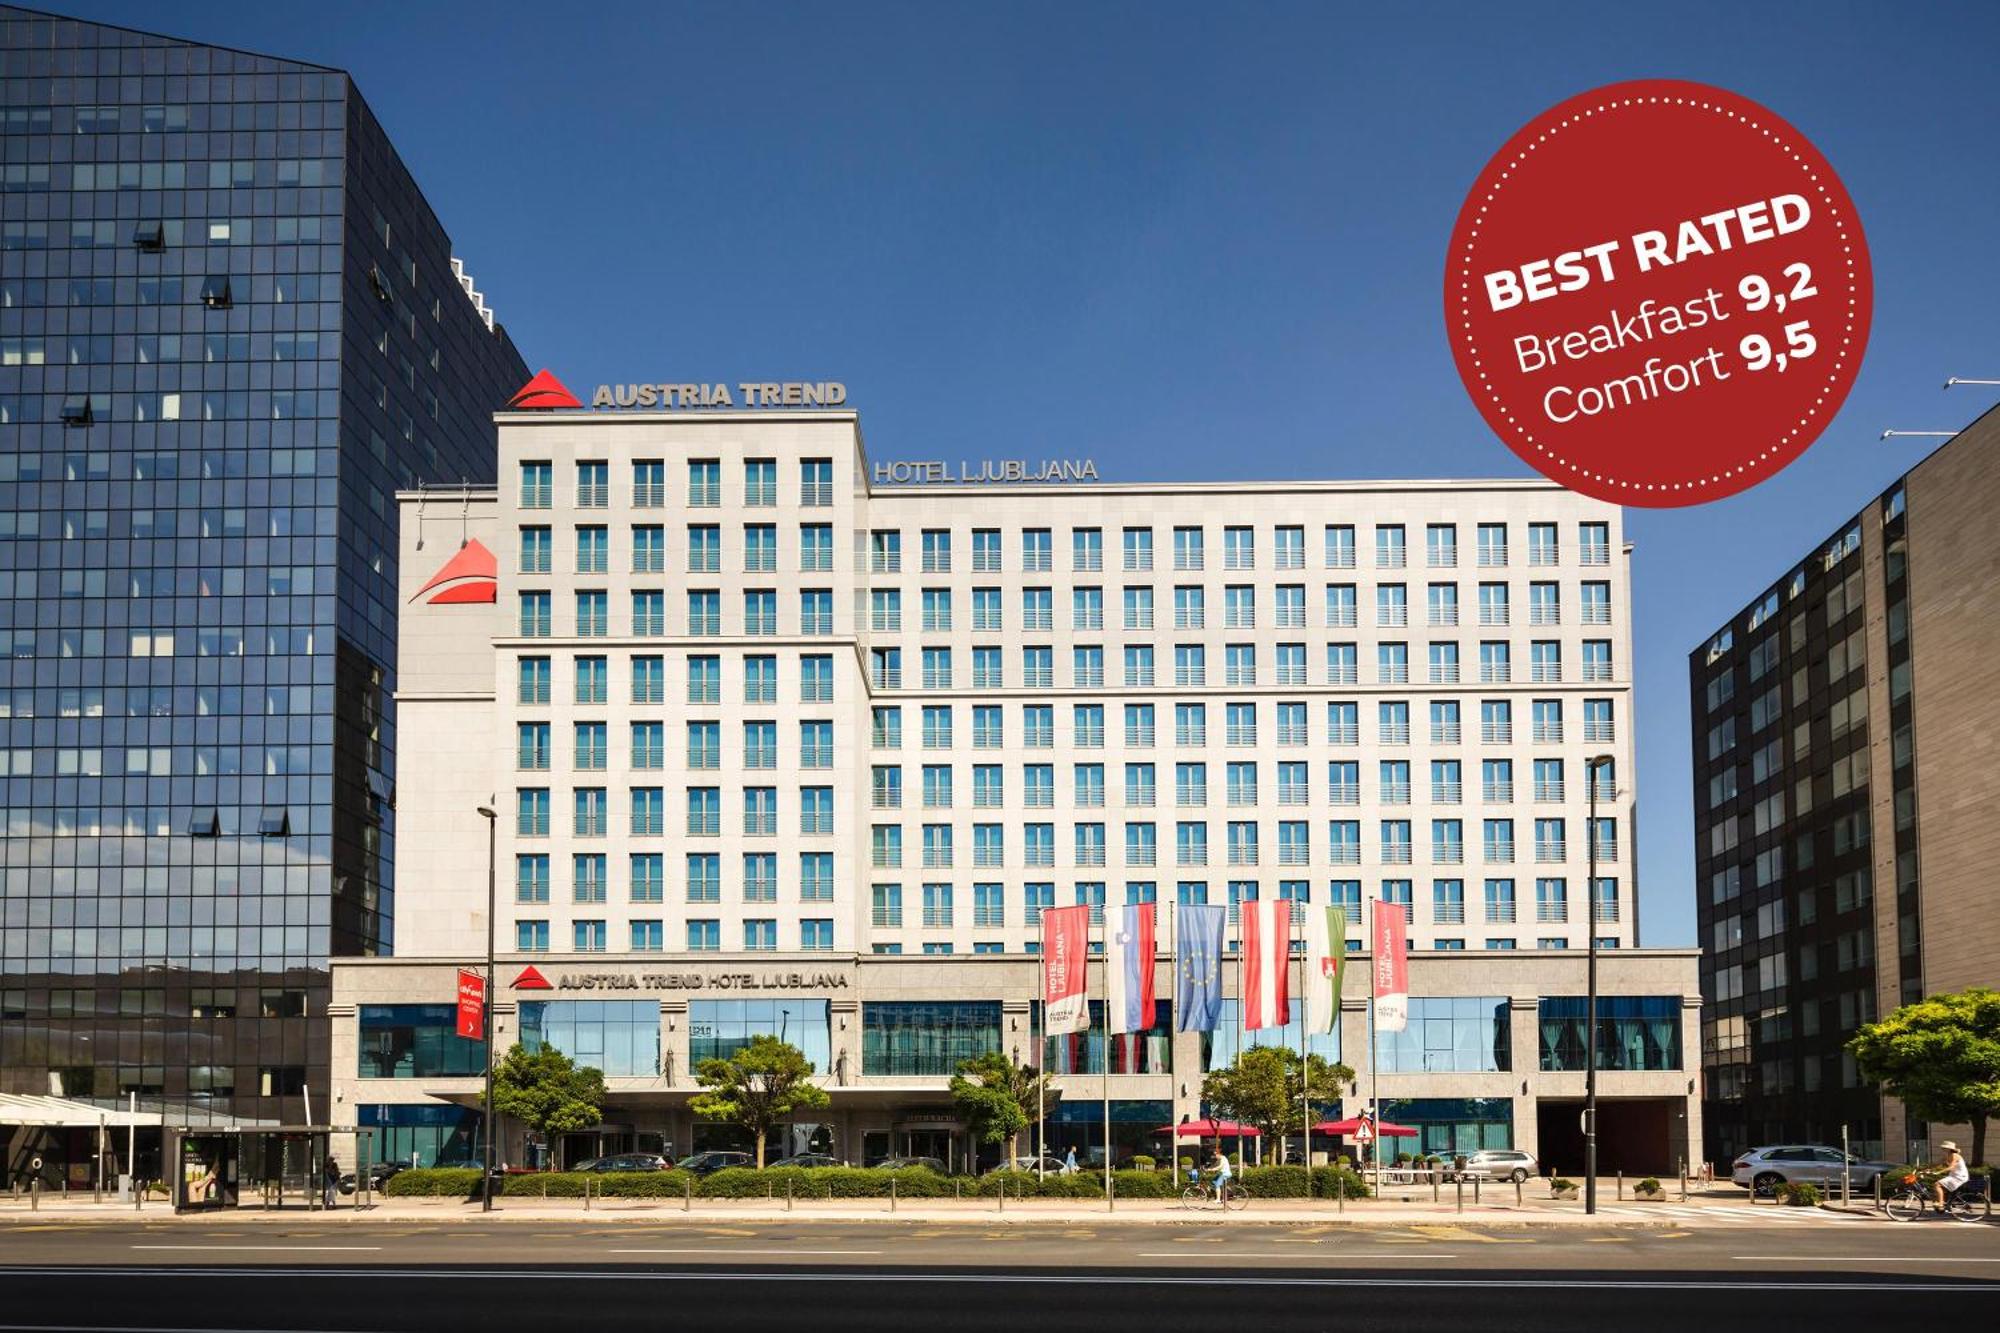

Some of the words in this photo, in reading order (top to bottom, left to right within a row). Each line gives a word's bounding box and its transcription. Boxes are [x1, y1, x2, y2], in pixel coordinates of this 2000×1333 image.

[592, 383, 733, 408] AUSTRIA
[739, 382, 847, 407] TREND
[874, 460, 956, 482] HOTEL
[961, 459, 1099, 482] LJUBLJANA
[1056, 932, 1065, 993] LJUBLJANA
[1384, 928, 1393, 989] LJUBLJANA
[558, 973, 639, 990] AUSTRIA
[643, 973, 704, 990] TREND
[708, 973, 760, 989] HOTEL
[763, 973, 849, 989] LJUBLJANA
[1049, 959, 1057, 994] HOTEL
